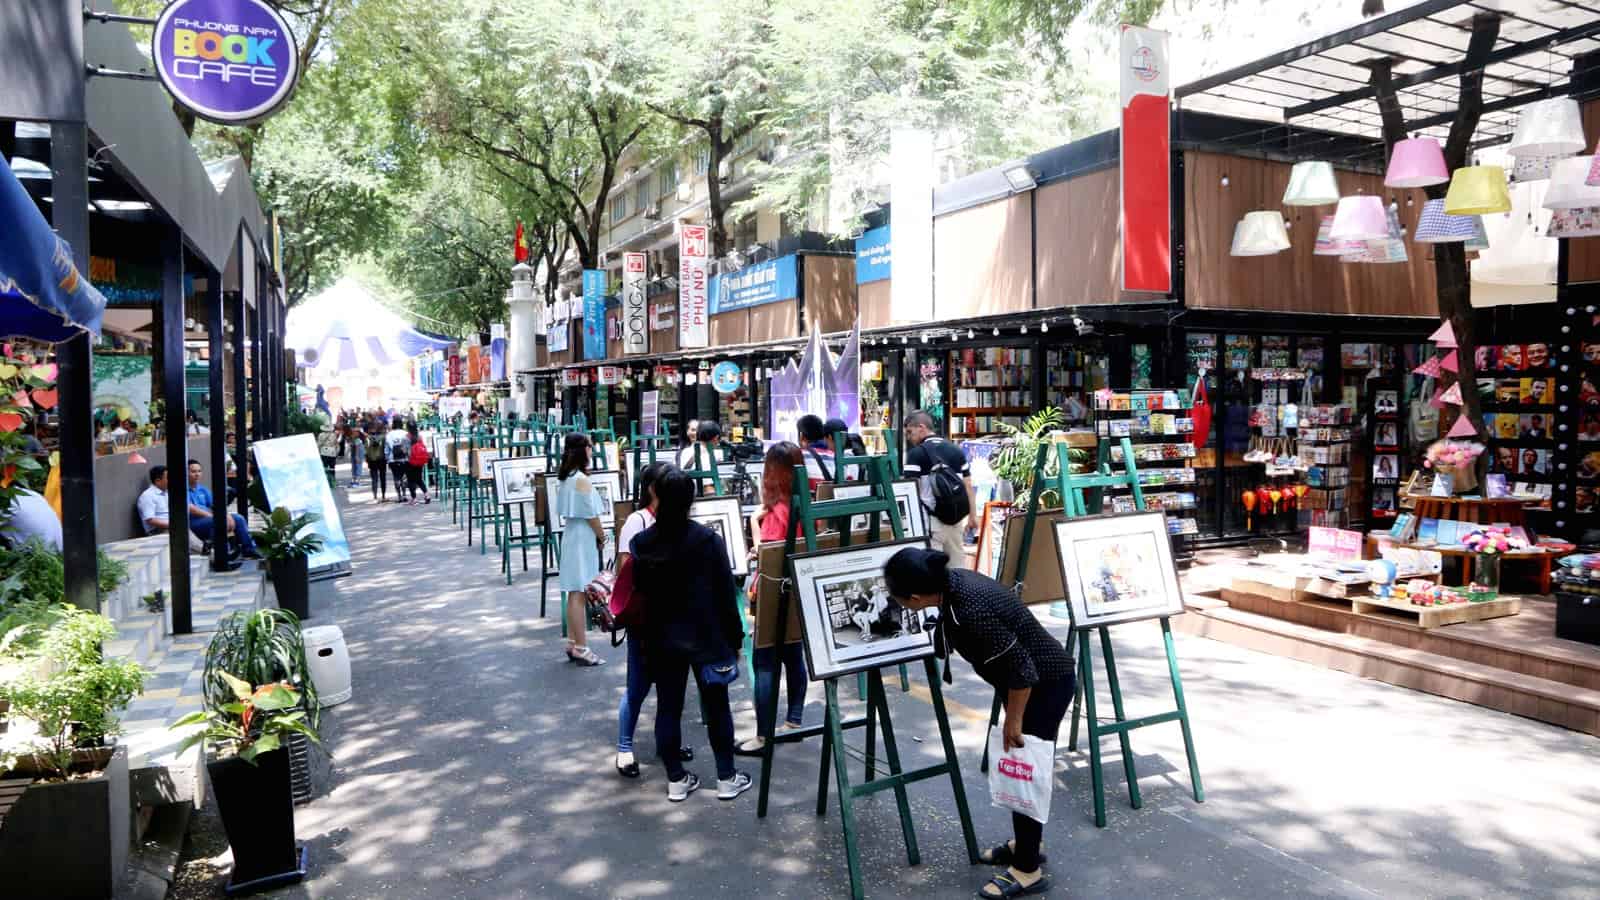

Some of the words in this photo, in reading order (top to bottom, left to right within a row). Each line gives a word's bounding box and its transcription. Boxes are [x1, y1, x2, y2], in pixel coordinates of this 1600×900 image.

[174, 18, 240, 33] PHUONG
[243, 26, 277, 37] NAM
[173, 28, 276, 66] BOOK
[173, 58, 277, 87] CAFE
